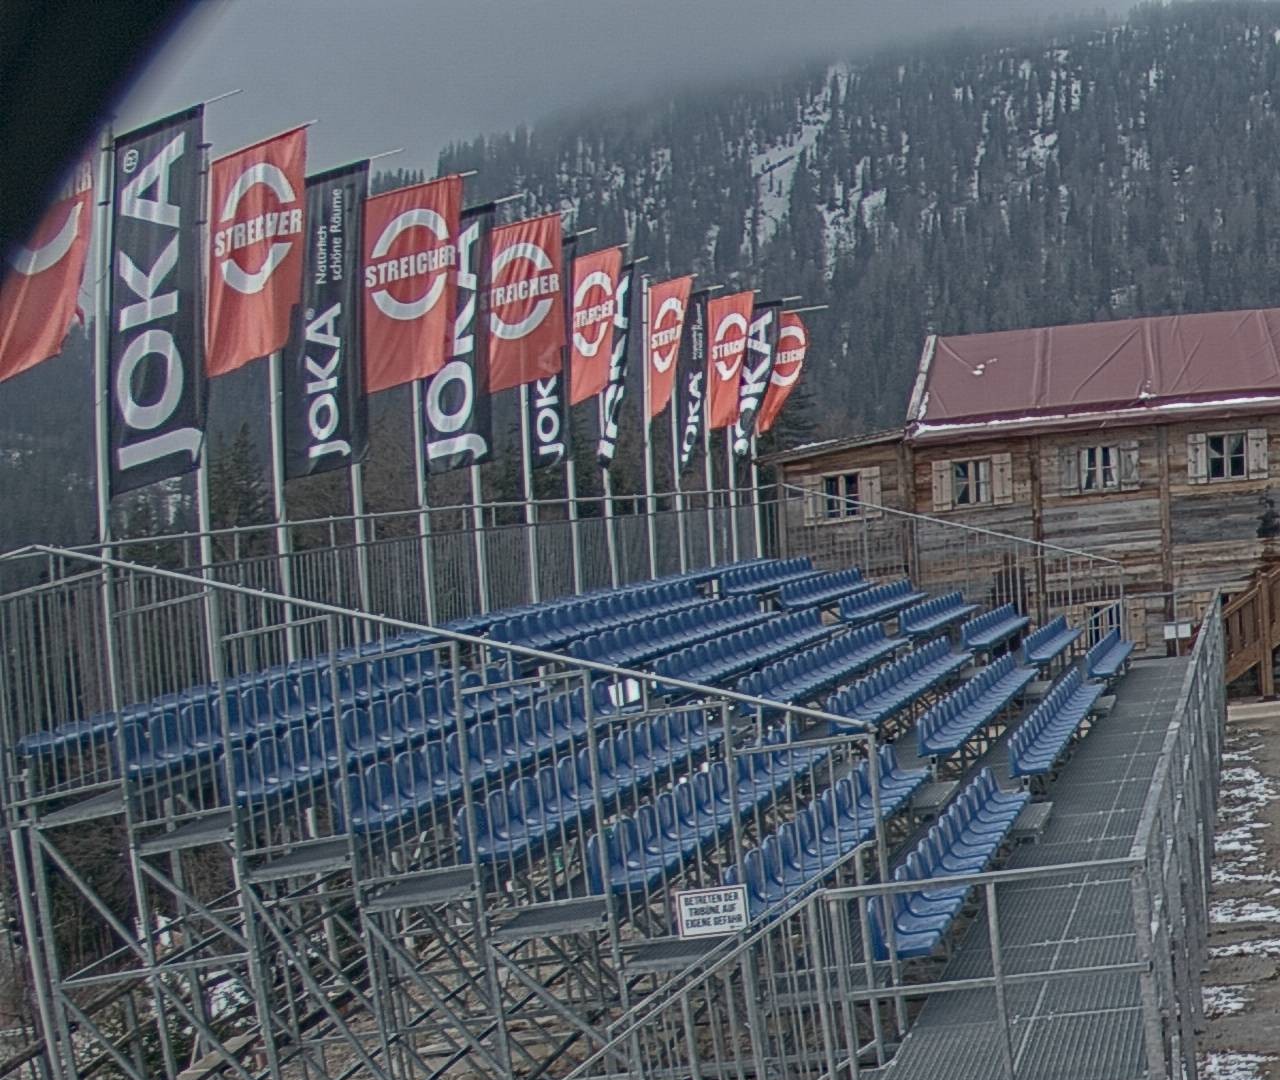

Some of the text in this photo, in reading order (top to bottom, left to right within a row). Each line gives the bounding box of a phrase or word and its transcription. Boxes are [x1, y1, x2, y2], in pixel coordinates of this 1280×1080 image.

[315, 225, 327, 285] Natürlich
[330, 188, 343, 281] schöne Räume
[365, 245, 456, 287] STREICHER
[117, 131, 203, 471] JOKA
[305, 302, 351, 459] JOKA
[536, 374, 564, 457] JOK
